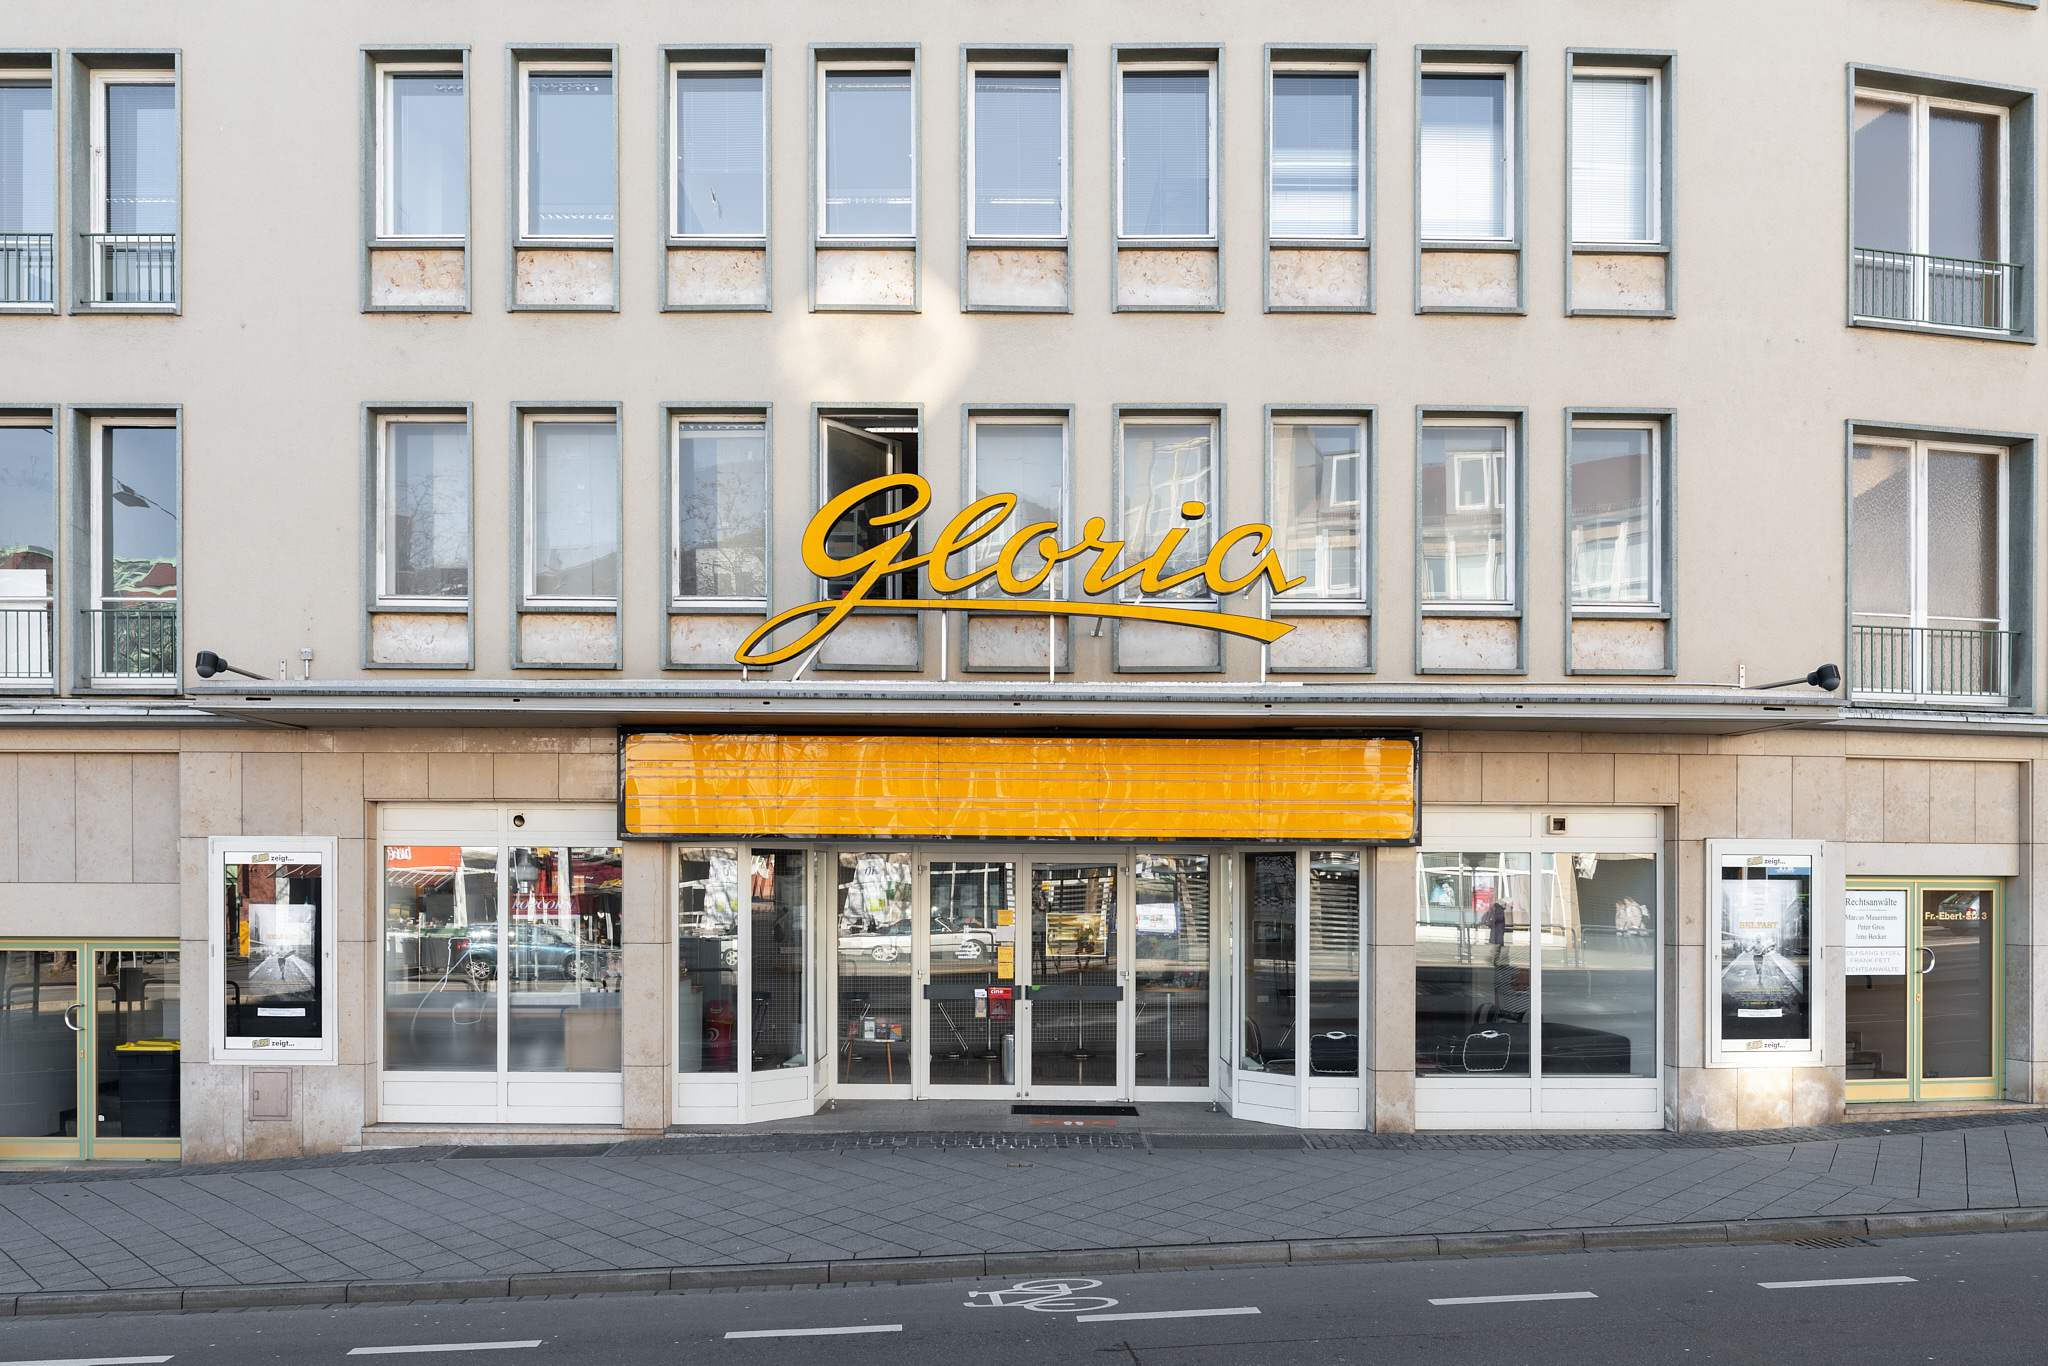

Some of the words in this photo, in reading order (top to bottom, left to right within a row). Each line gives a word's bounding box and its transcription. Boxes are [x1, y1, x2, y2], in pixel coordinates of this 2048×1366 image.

[734, 472, 1307, 666] Gloria
[1845, 897, 1898, 907] Rechtsanwälte
[1981, 911, 1988, 921] 3
[1739, 921, 1779, 929] BELFAST
